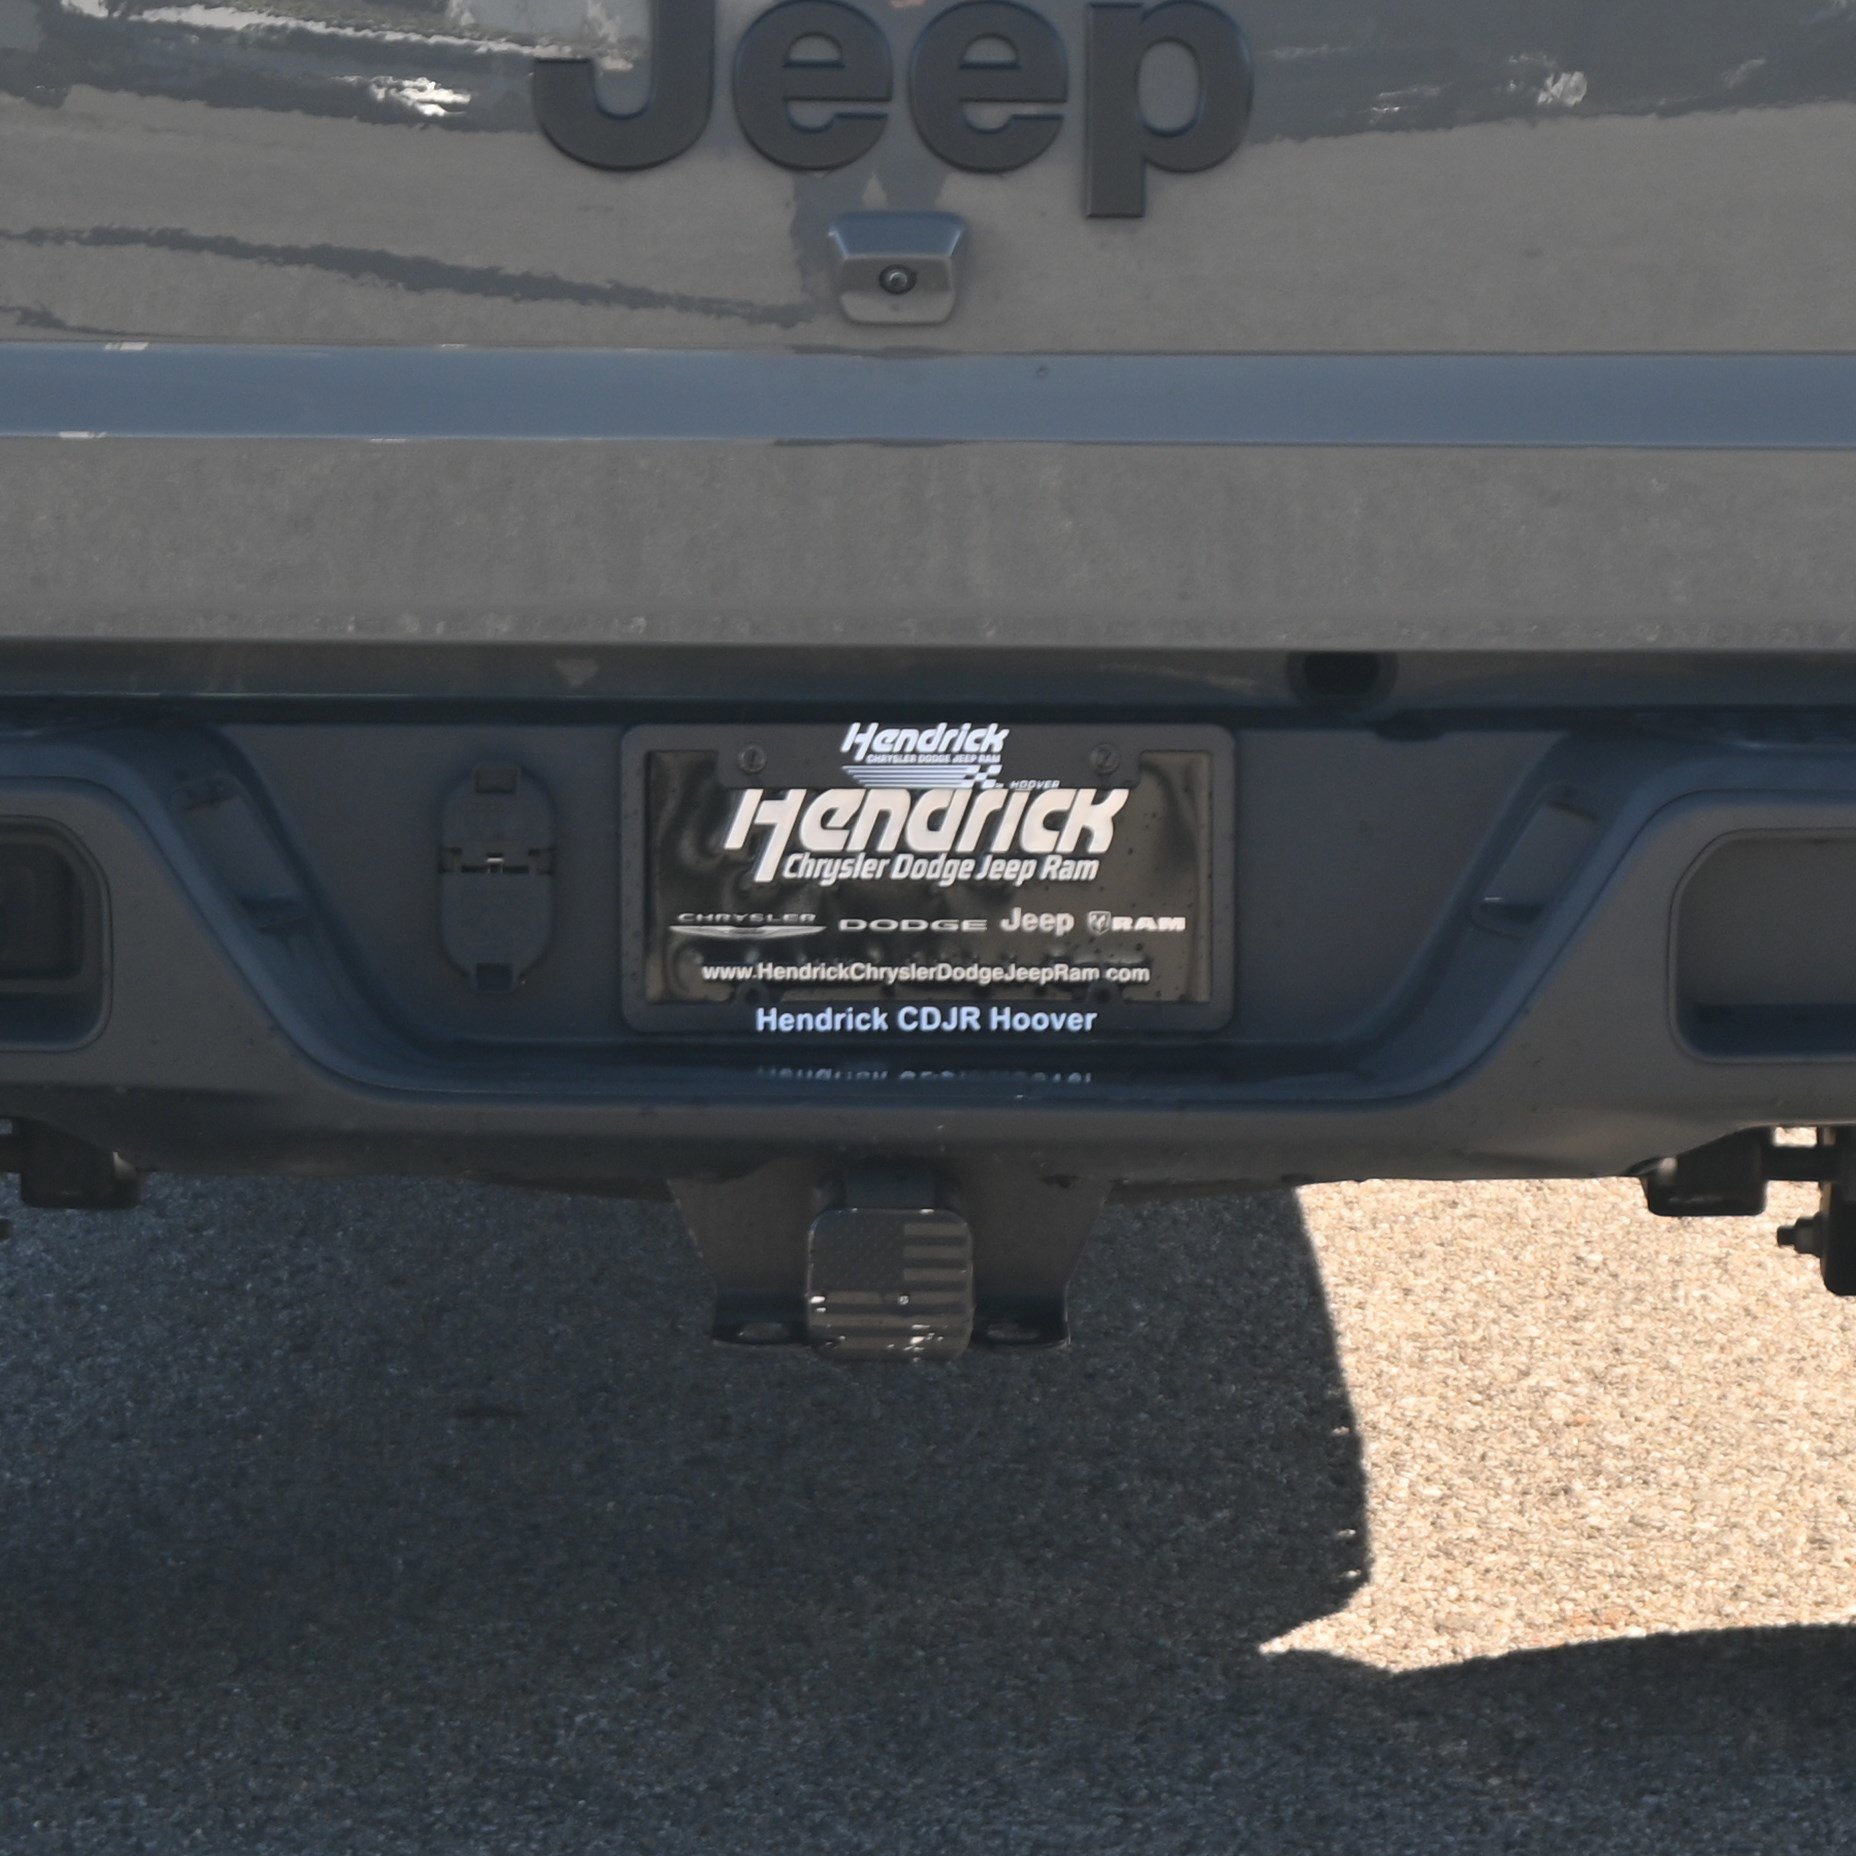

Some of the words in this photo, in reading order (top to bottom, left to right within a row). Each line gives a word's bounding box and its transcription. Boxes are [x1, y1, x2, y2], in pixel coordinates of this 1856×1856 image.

[840, 721, 1011, 763] Hendrick
[866, 754, 917, 764] CHRYSLER
[918, 754, 951, 764] DODGE
[951, 754, 978, 764] JEEP
[1010, 779, 1060, 789] HOOVER
[723, 787, 1130, 883] Hendrick
[783, 852, 891, 887] Chrysler
[891, 853, 976, 887] Dodge
[975, 855, 1038, 887] Jeep
[1040, 854, 1100, 882] Ram
[677, 912, 817, 922] CHRYSLER
[838, 918, 988, 932] DODGE
[999, 907, 1076, 936] Jeep
[1111, 916, 1186, 932] RAM
[702, 961, 1151, 987] www.HendrickChryslerDodgeJeepRamcom
[755, 1007, 889, 1032] Hendrick
[897, 1006, 982, 1032] CDJR
[990, 1006, 1098, 1032] Hoover
